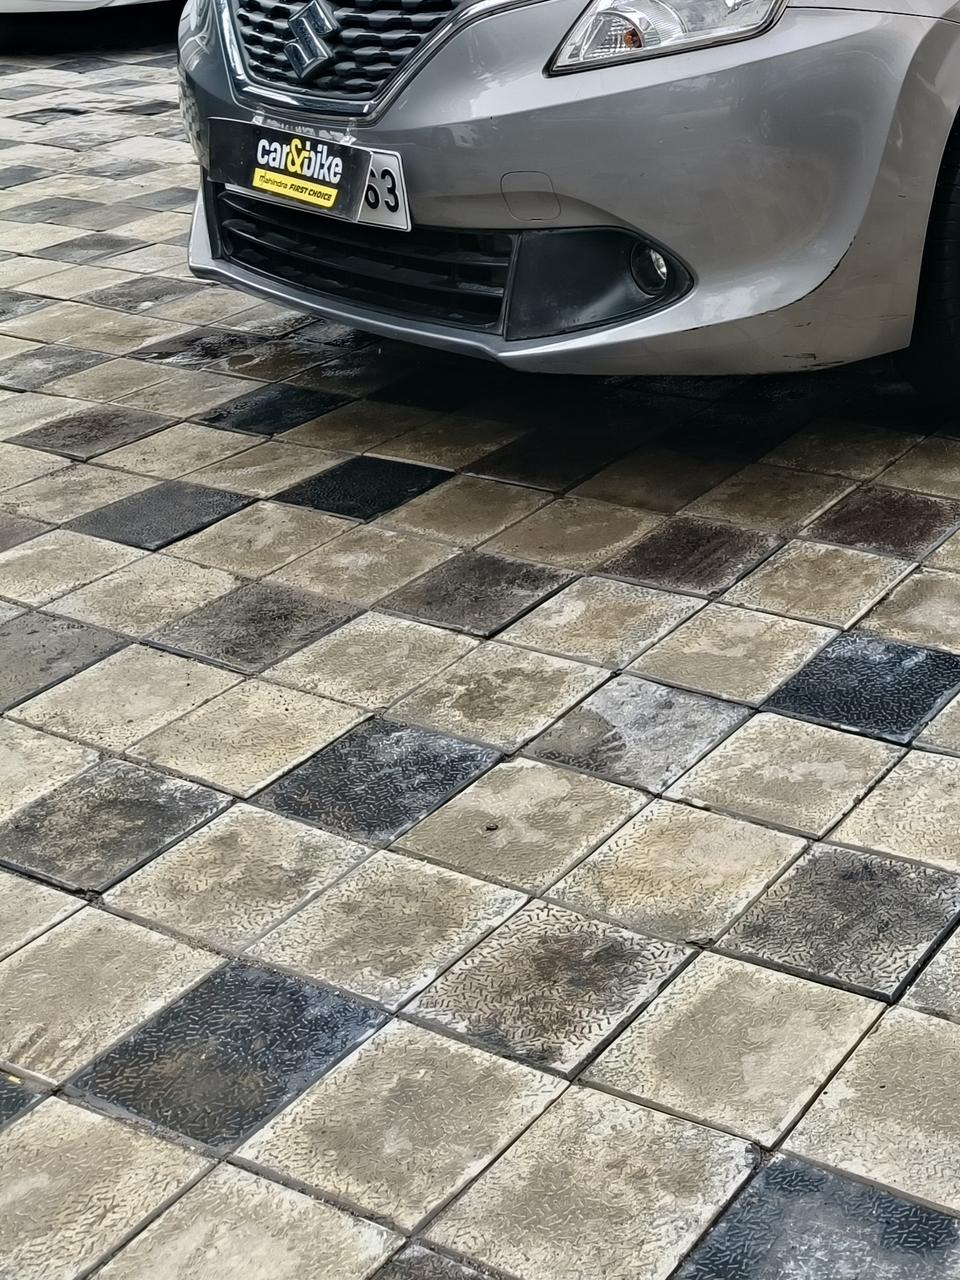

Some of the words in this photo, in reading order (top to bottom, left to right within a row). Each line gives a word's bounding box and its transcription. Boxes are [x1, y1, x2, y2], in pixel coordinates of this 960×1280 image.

[257, 138, 343, 184] car&bike
[288, 183, 309, 195] FIRST
[308, 189, 333, 202] CHOICE
